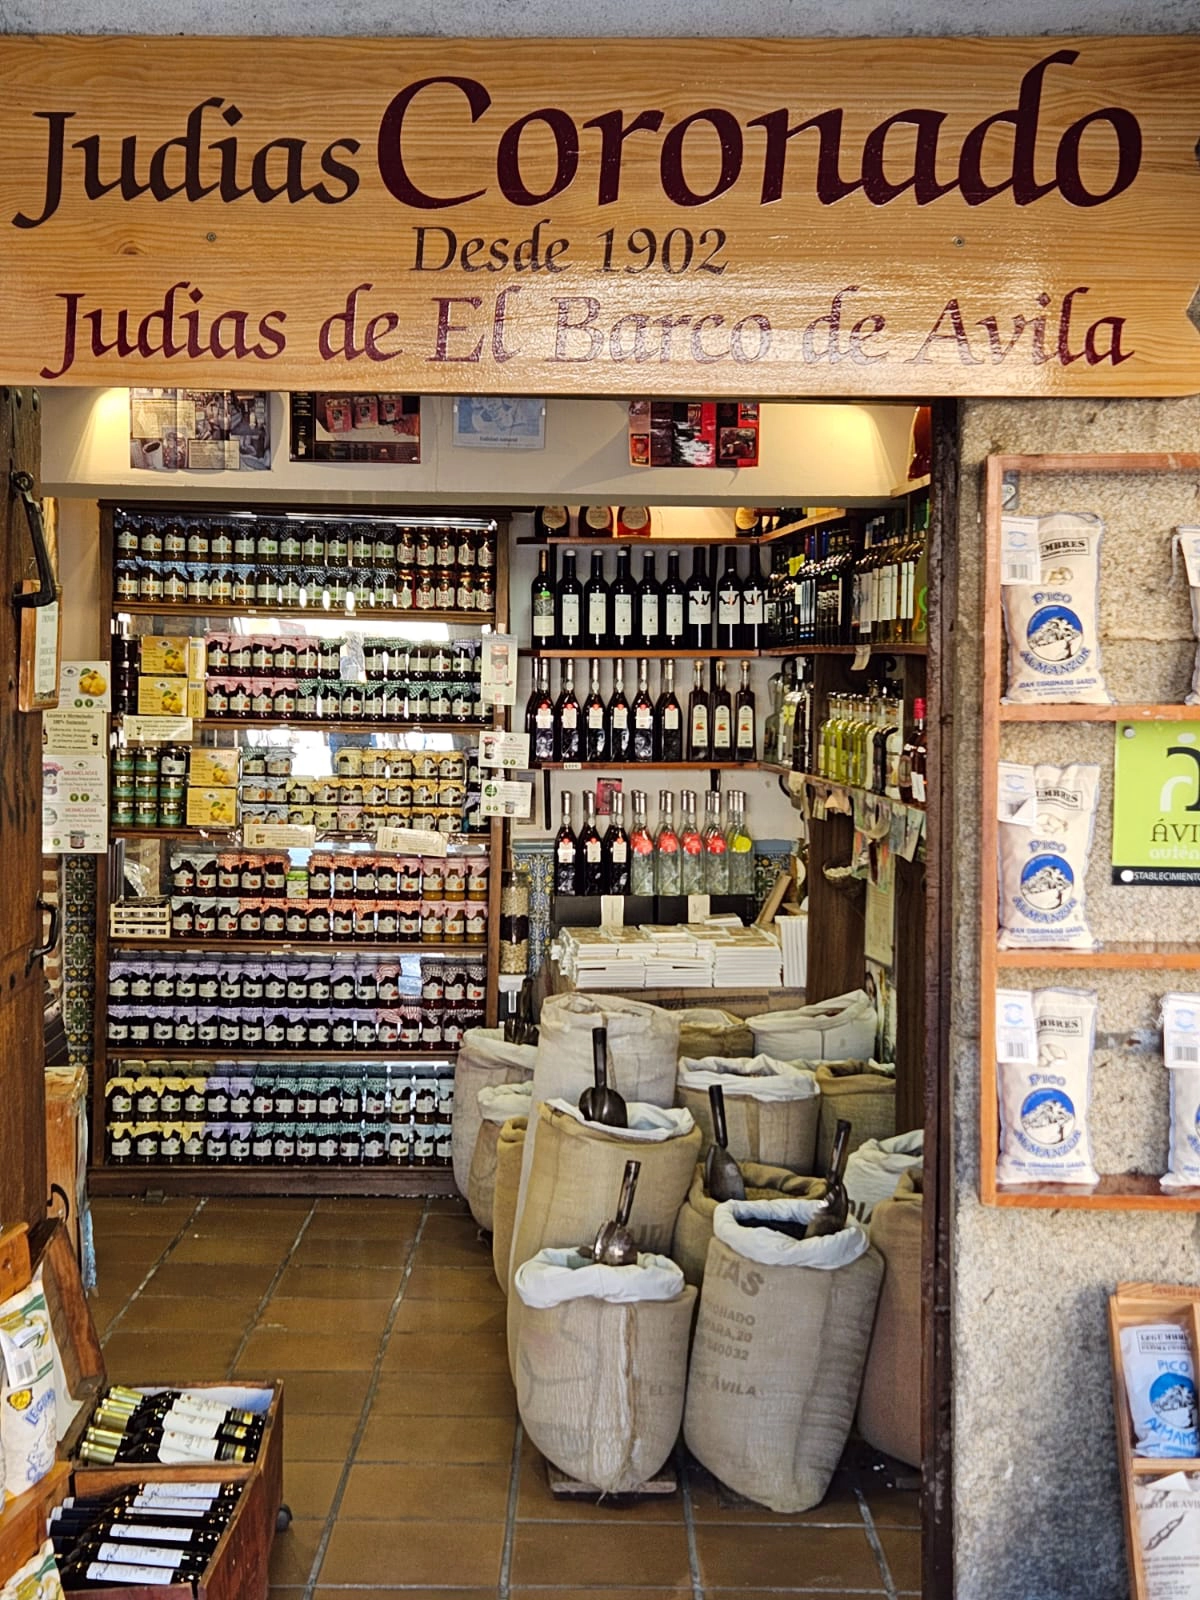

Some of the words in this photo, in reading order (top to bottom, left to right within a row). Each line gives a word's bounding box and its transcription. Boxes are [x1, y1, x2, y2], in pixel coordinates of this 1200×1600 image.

[12, 97, 361, 229] Judias
[378, 49, 1143, 210] Coronado
[410, 218, 571, 273] Desde
[595, 227, 729, 275] 1902
[40, 281, 286, 380] Judias
[320, 283, 403, 362] de
[427, 285, 521, 364] El
[544, 296, 773, 366] Barco
[802, 285, 889, 367] de
[905, 286, 1135, 367] Avila
[1041, 540, 1086, 552] MBRES
[1150, 818, 1199, 843] ÁVI
[1133, 871, 1200, 881] STABLECIMIENTO
[1039, 1018, 1079, 1029] MBRES
[1157, 1359, 1190, 1373] PICO
[1144, 1416, 1200, 1446] ALMANZ
